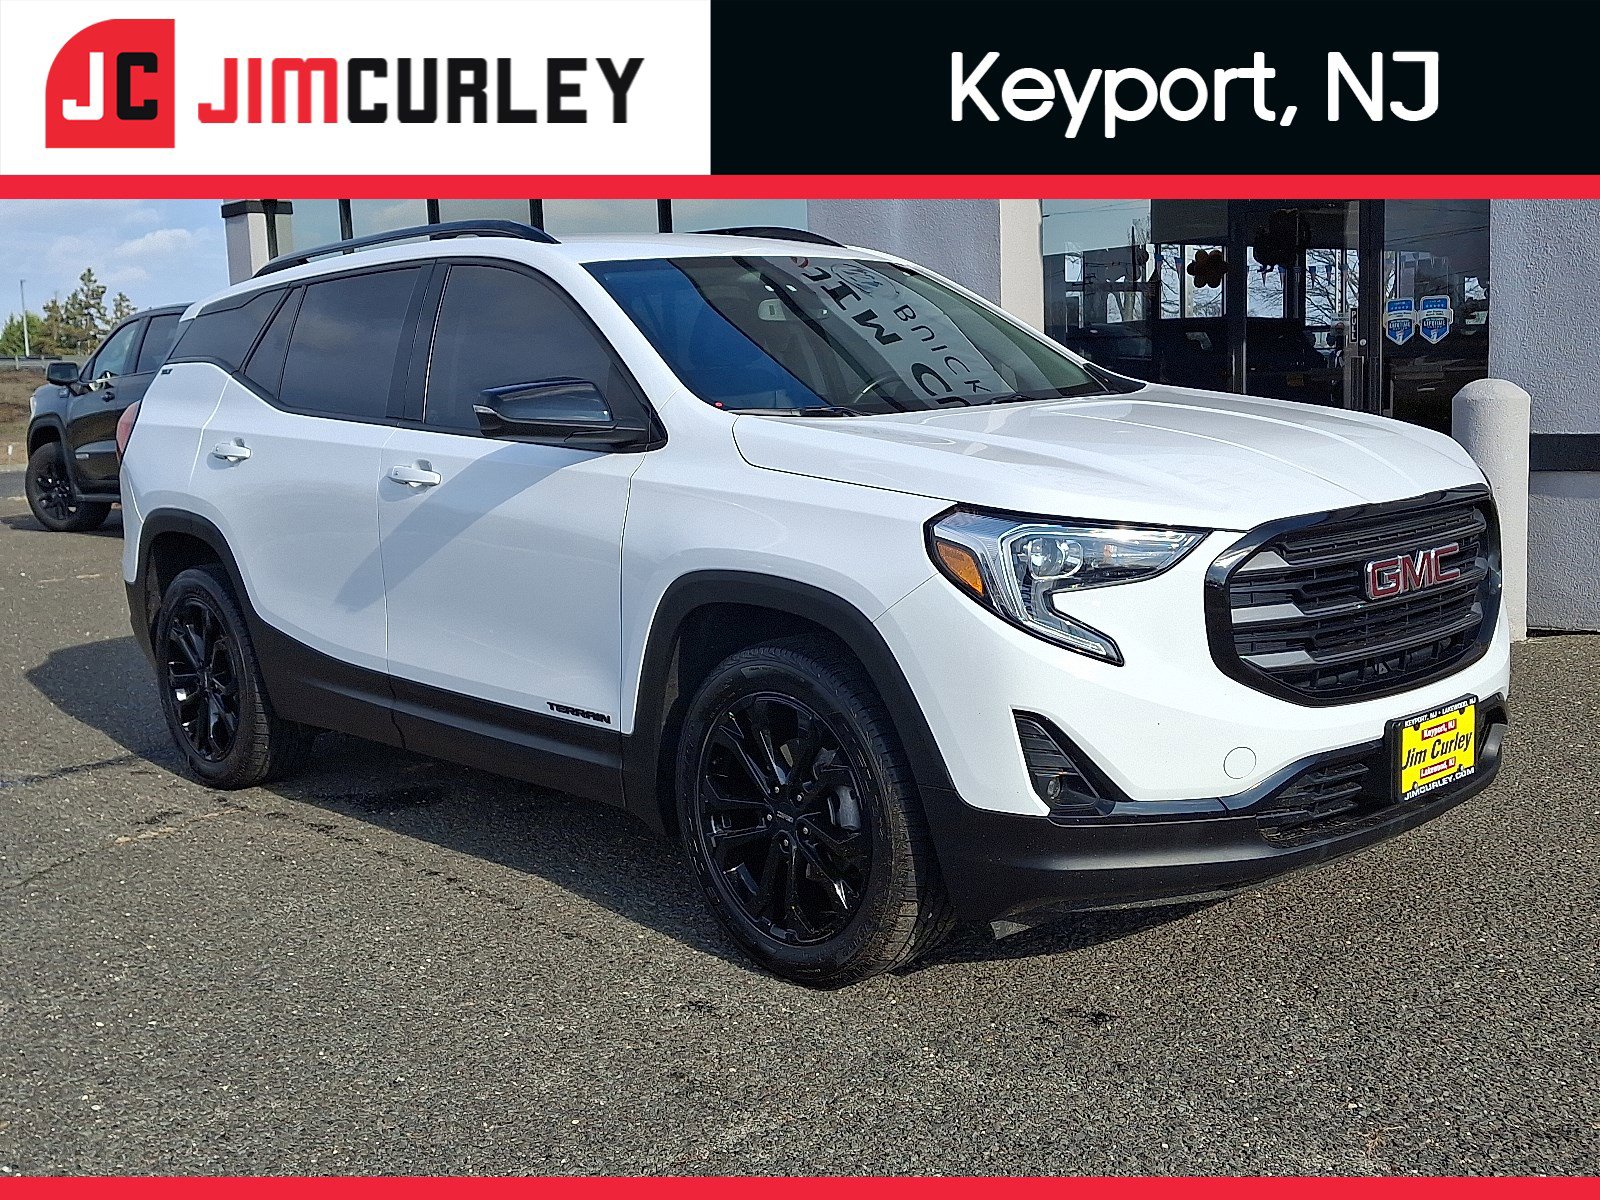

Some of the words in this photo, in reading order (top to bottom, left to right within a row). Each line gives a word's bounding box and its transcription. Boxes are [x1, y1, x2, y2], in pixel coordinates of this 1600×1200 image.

[1364, 542, 1461, 601] GMC
[546, 701, 612, 725] TERRAIN
[1401, 747, 1428, 770] Jim
[1430, 731, 1473, 760] Curley
[1404, 766, 1475, 801] JIMCURLEY.COM
